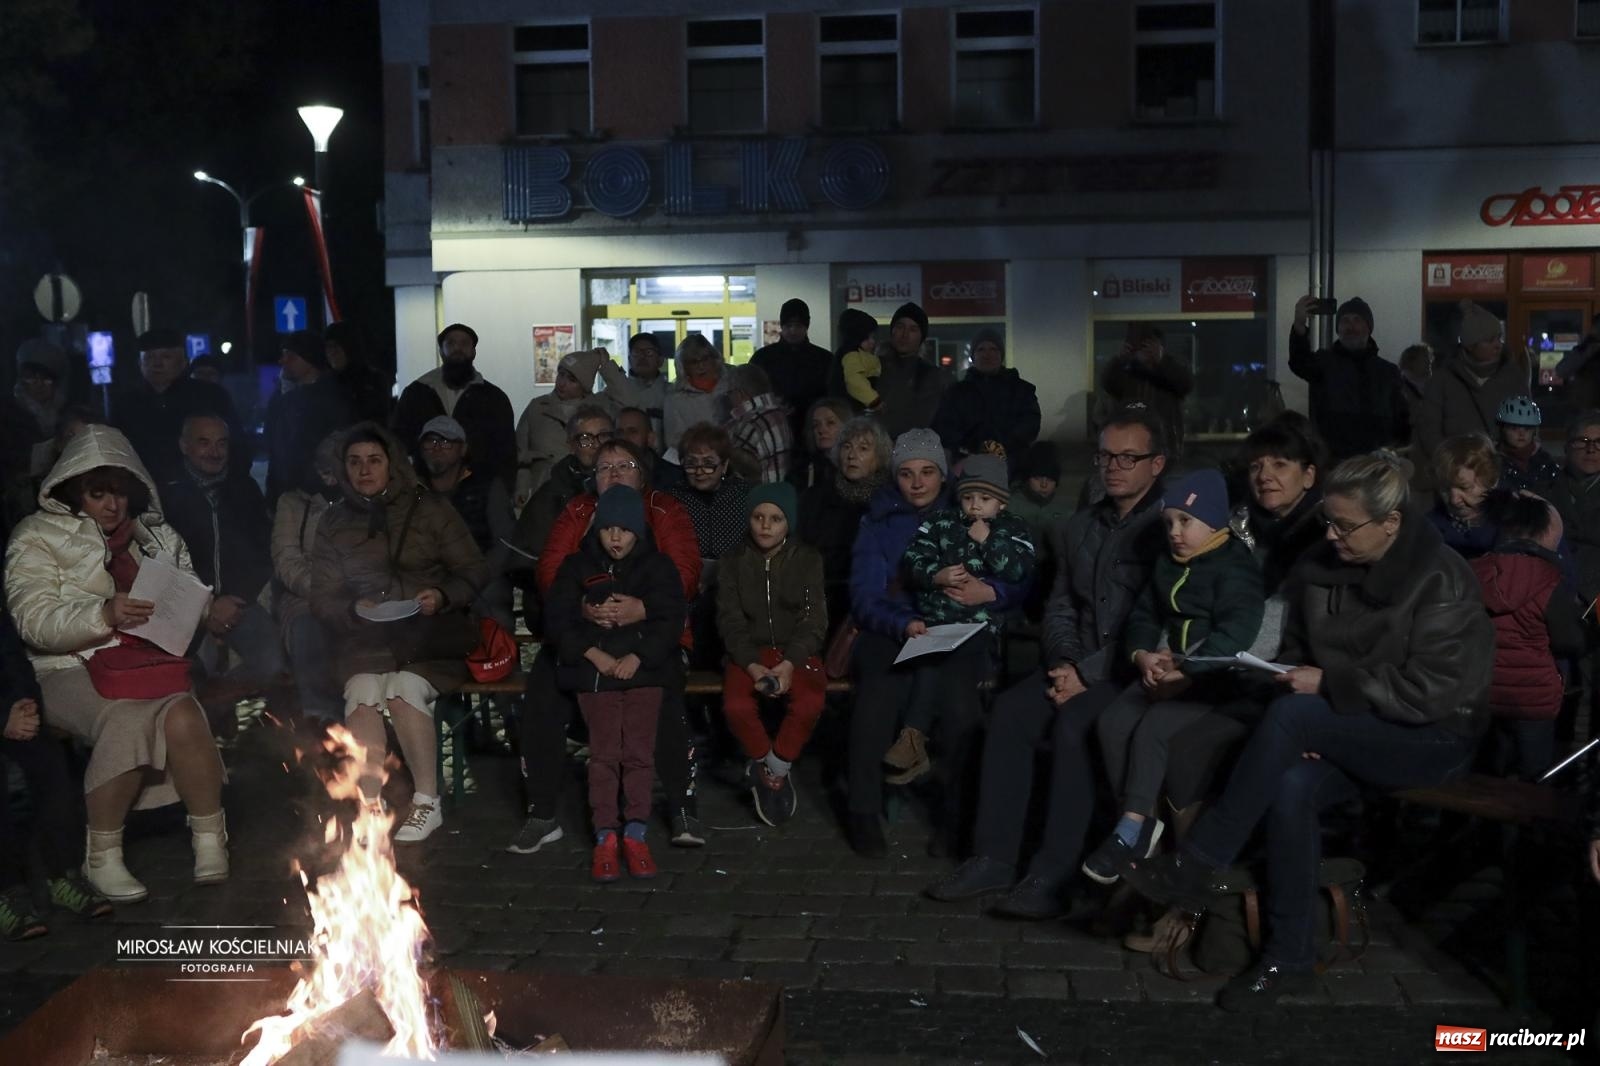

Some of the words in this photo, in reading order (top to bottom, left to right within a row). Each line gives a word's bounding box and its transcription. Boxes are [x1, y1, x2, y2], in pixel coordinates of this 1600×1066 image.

[503, 138, 889, 221] BOLKO
[865, 283, 912, 298] Bliski
[1123, 277, 1171, 293] Bliski
